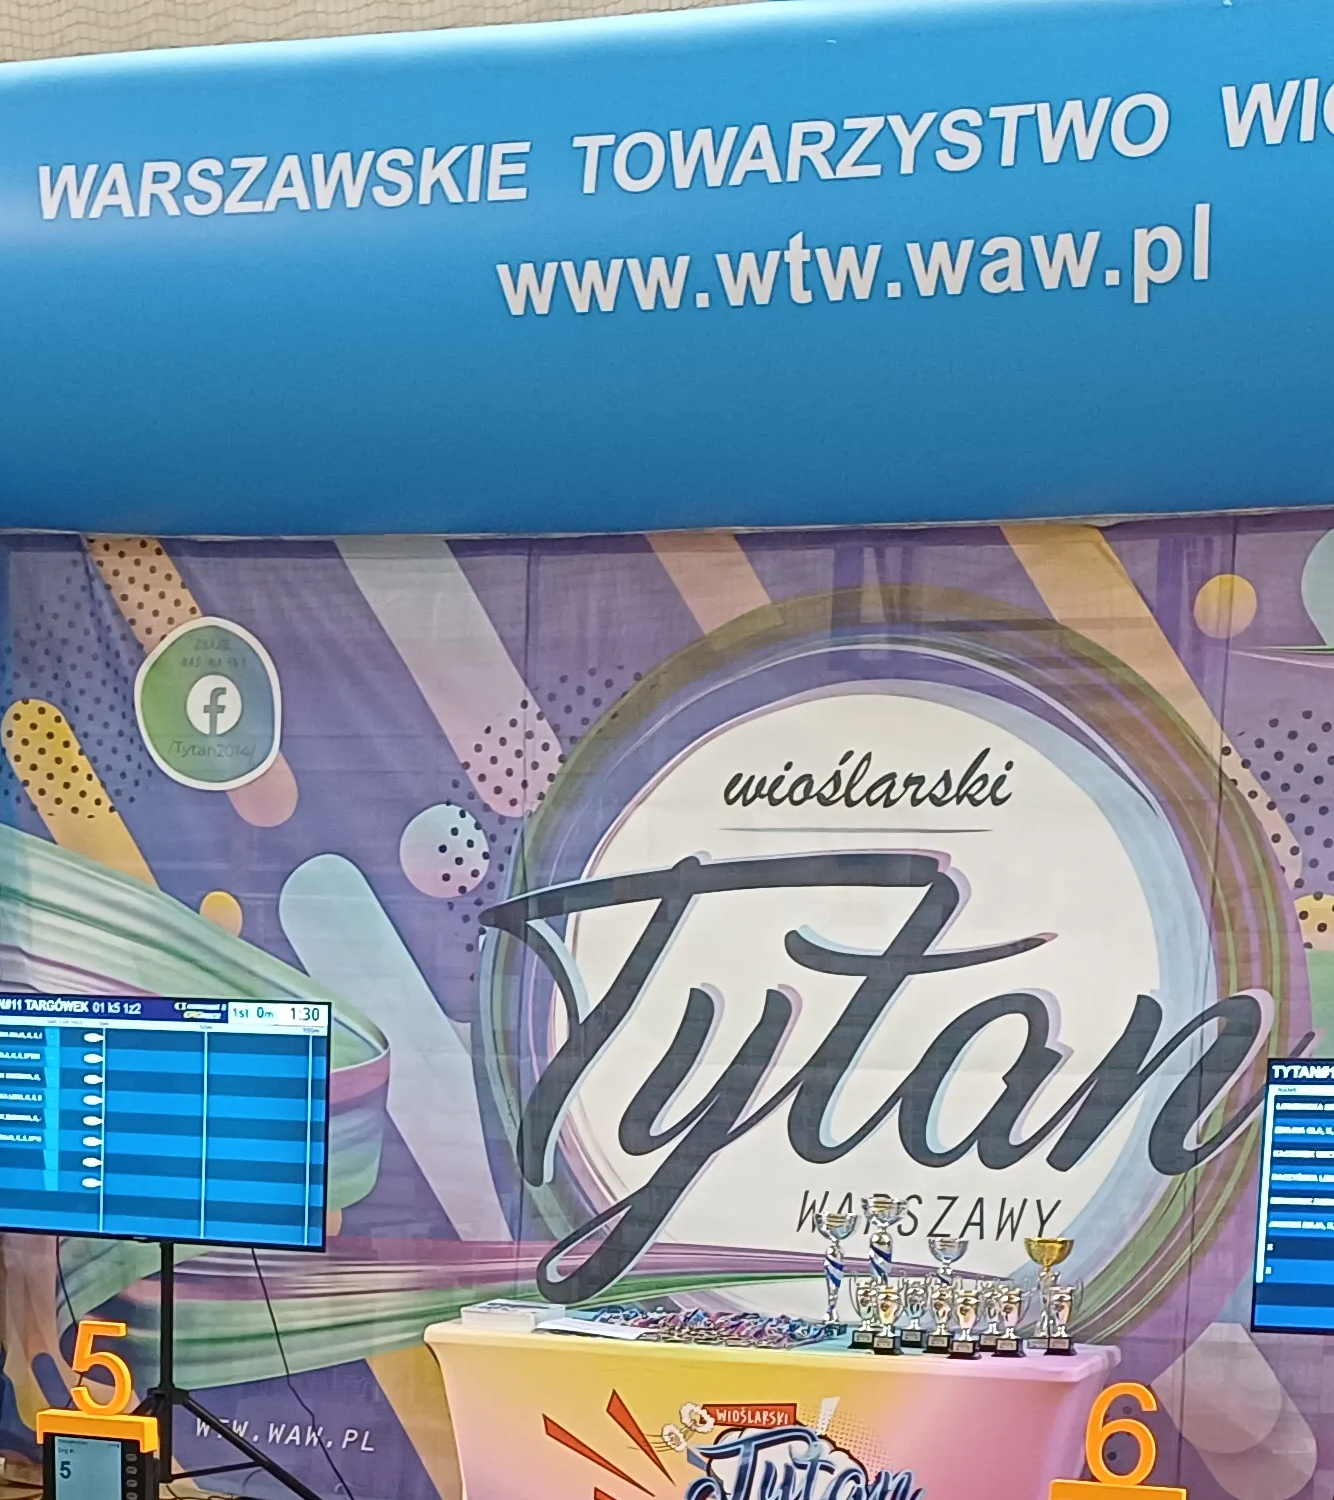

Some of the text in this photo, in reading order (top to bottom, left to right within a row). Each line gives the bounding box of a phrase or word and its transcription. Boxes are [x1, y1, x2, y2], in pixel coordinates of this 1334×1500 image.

[37, 140, 532, 220] WARSZAWSKIE
[571, 91, 1172, 195] TOWARZYSTWO
[495, 202, 1214, 317] www.wtw.waw.pl
[722, 746, 1014, 809] wioślarski
[24, 997, 89, 1013] TARGÓWEK
[92, 1001, 105, 1013] 01
[123, 1003, 142, 1015] 1z2
[289, 1006, 321, 1022] 1:30
[478, 850, 1316, 1304] Tytan
[70, 1319, 133, 1416] 5
[716, 1406, 789, 1426] WIOŚLARSKI
[1085, 1382, 1158, 1486] 6
[59, 1460, 72, 1480] 5
